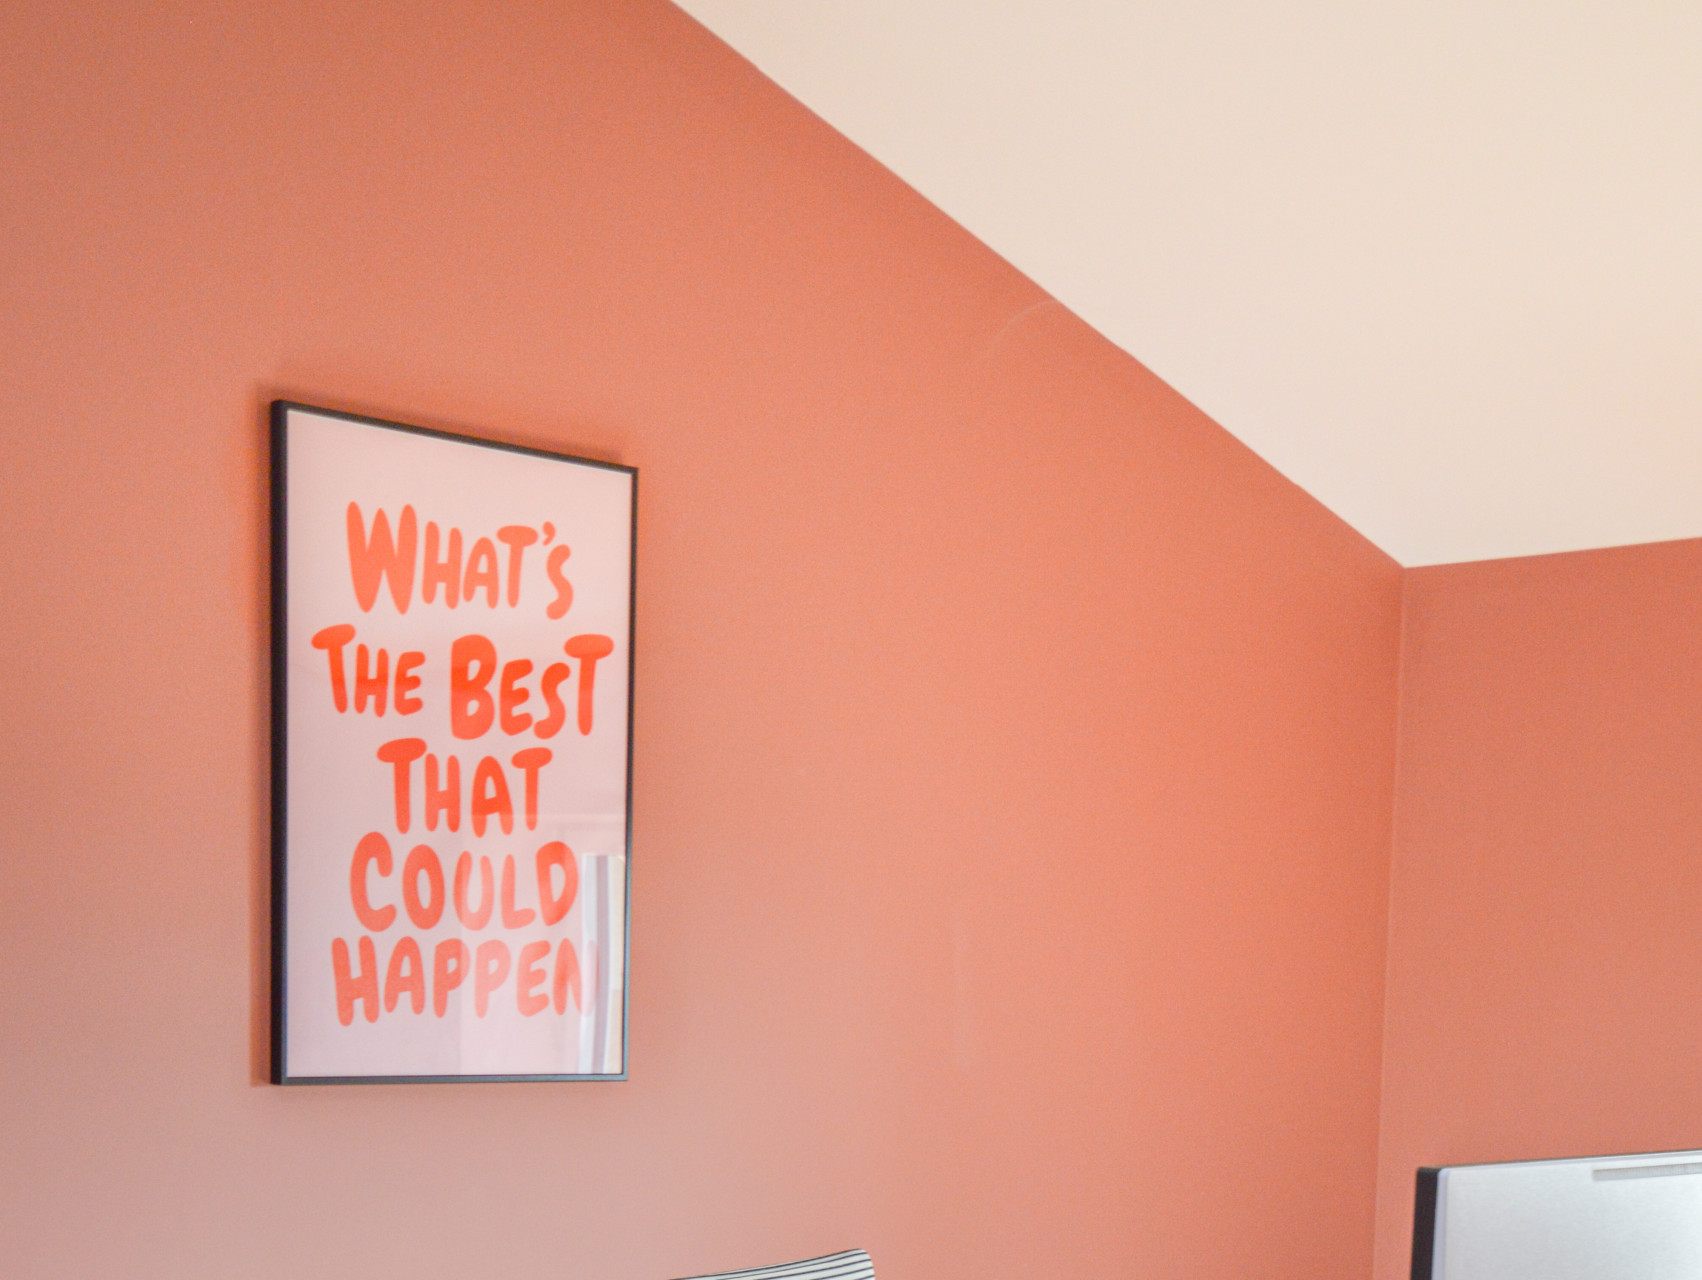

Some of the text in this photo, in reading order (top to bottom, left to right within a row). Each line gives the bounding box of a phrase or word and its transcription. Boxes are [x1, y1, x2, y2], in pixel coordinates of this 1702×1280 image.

[310, 623, 615, 741] THE BEST
[376, 737, 554, 838] THAT
[349, 831, 580, 932] COULD
[330, 935, 599, 1027] HAPPEN
